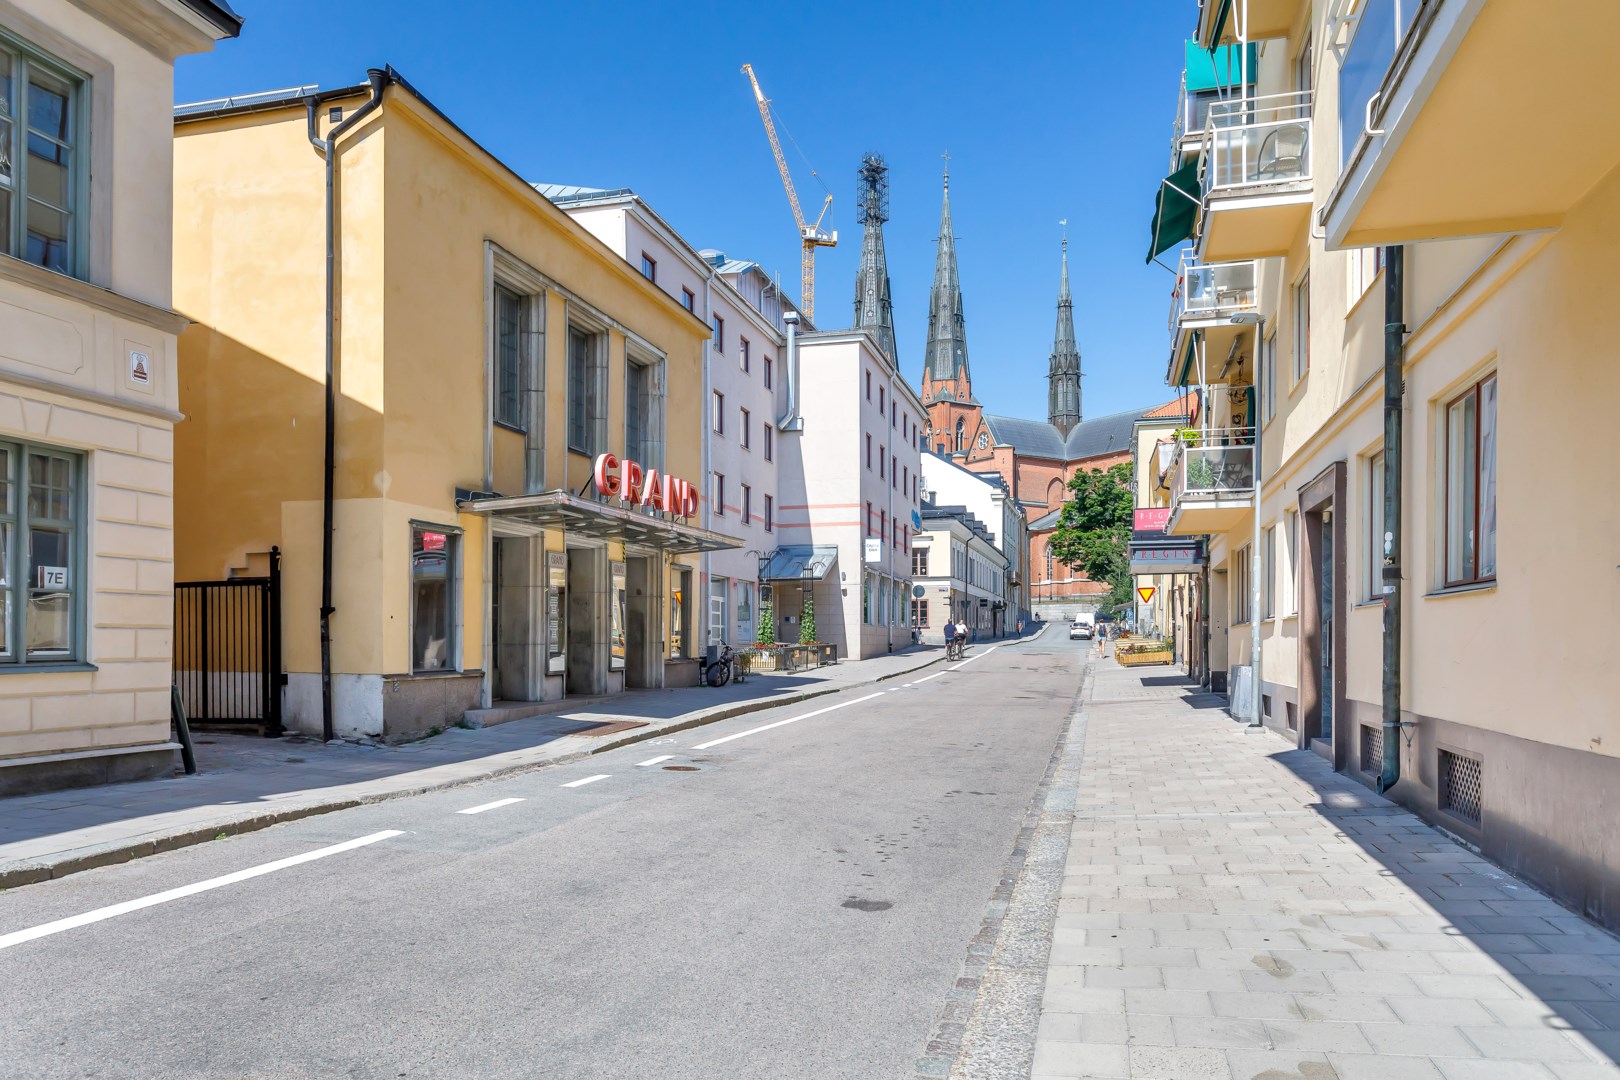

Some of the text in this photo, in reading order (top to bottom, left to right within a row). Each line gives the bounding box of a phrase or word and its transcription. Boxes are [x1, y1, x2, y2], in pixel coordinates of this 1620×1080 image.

[594, 453, 699, 518] GRAND
[551, 554, 564, 565] GRAND
[47, 572, 64, 584] 7E
